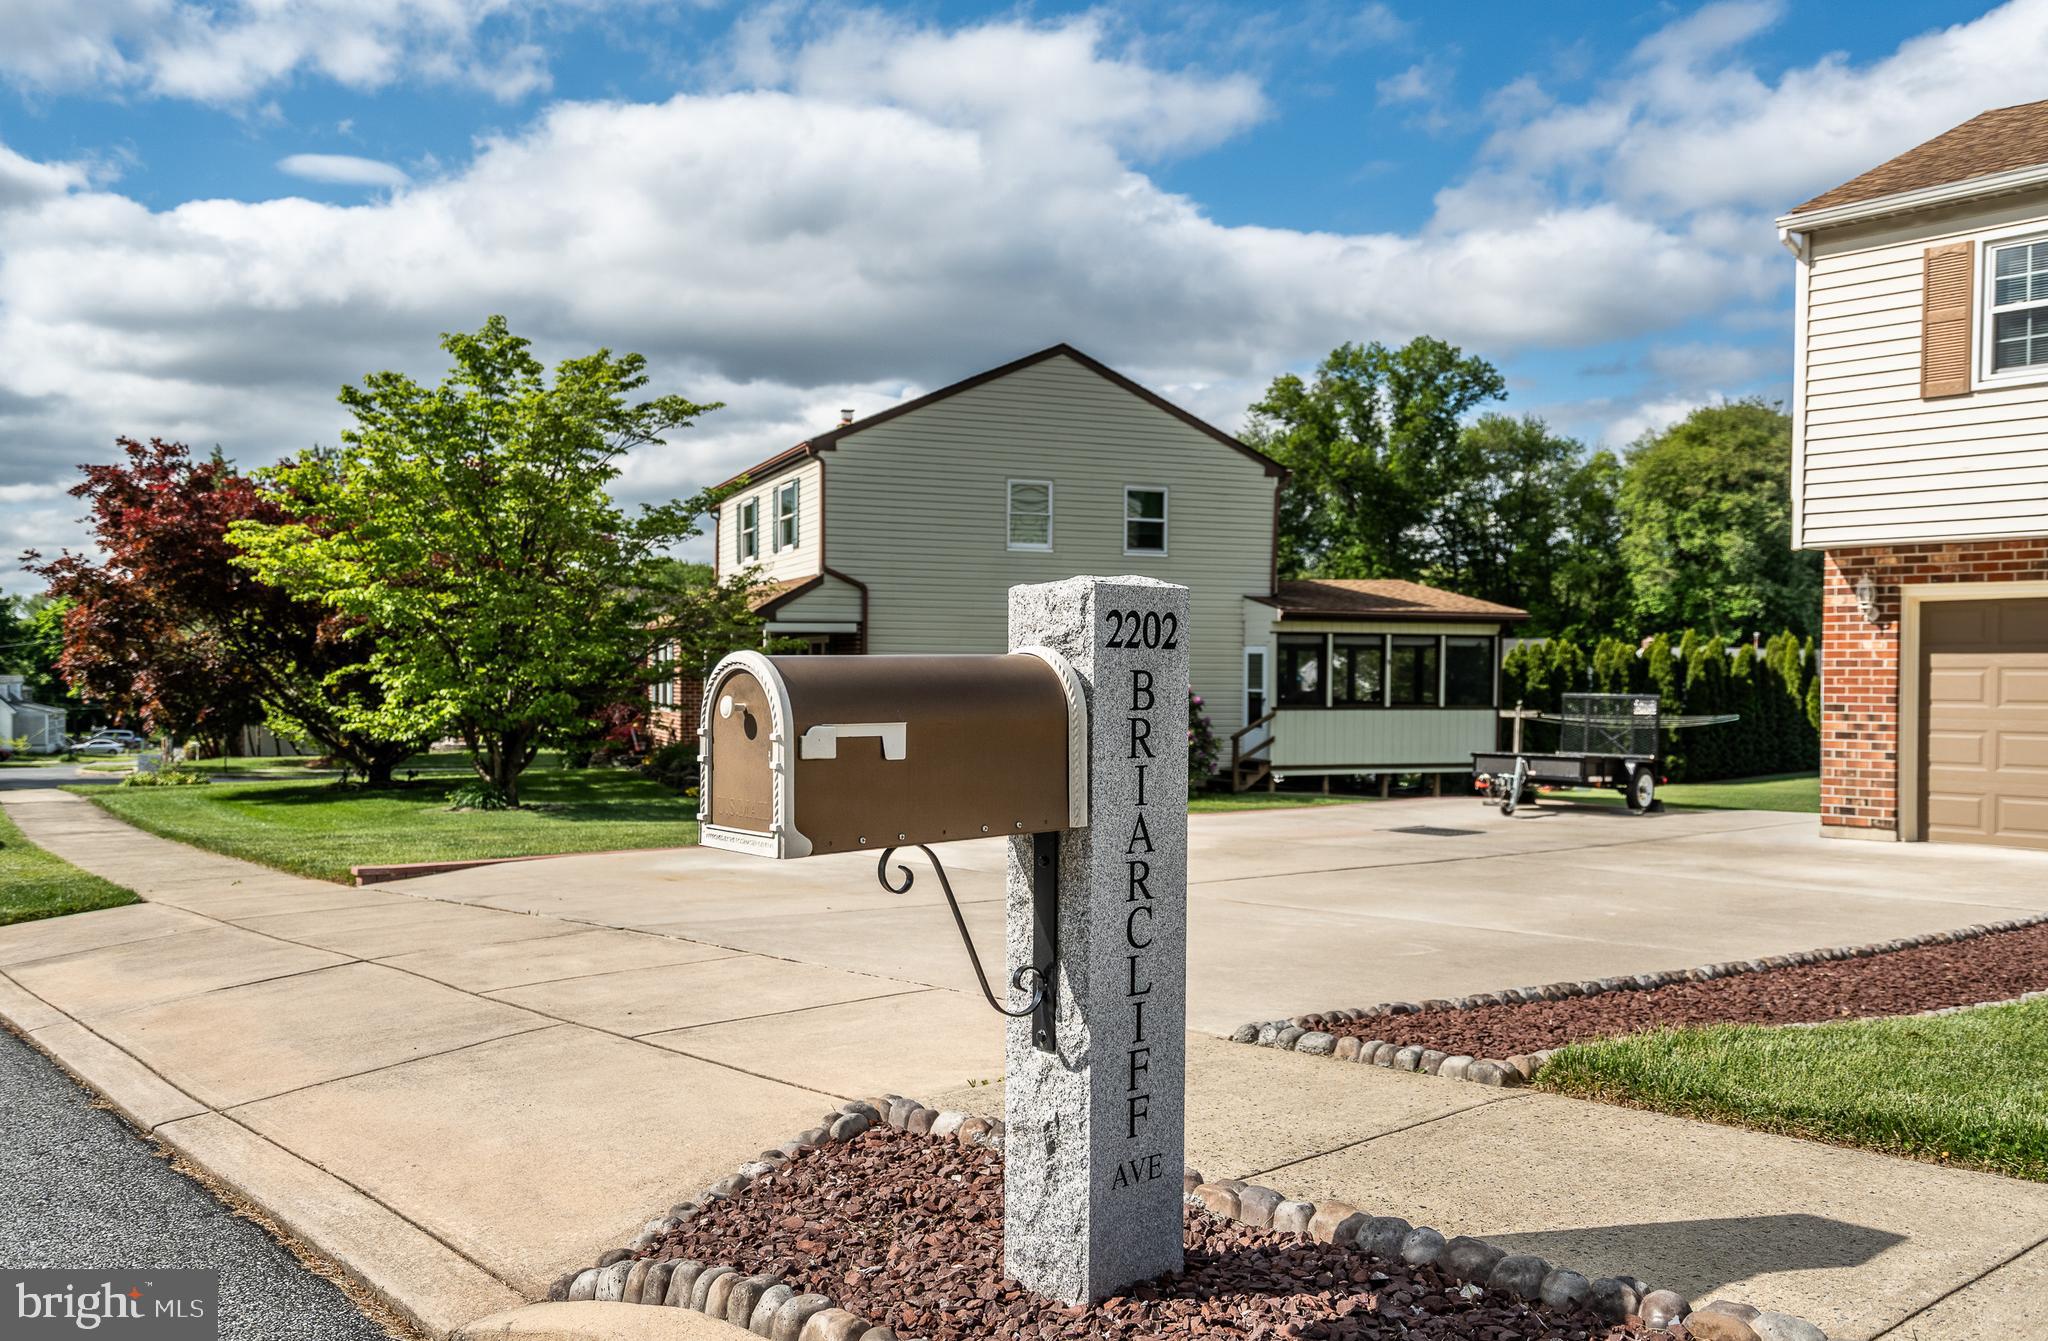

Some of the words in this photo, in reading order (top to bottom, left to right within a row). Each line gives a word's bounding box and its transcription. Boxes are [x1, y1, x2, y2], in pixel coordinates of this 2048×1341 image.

[1105, 609, 1179, 650] 2202
[1125, 669, 1156, 1140] BRIARCLIFF
[1111, 1153, 1163, 1191] AVE
